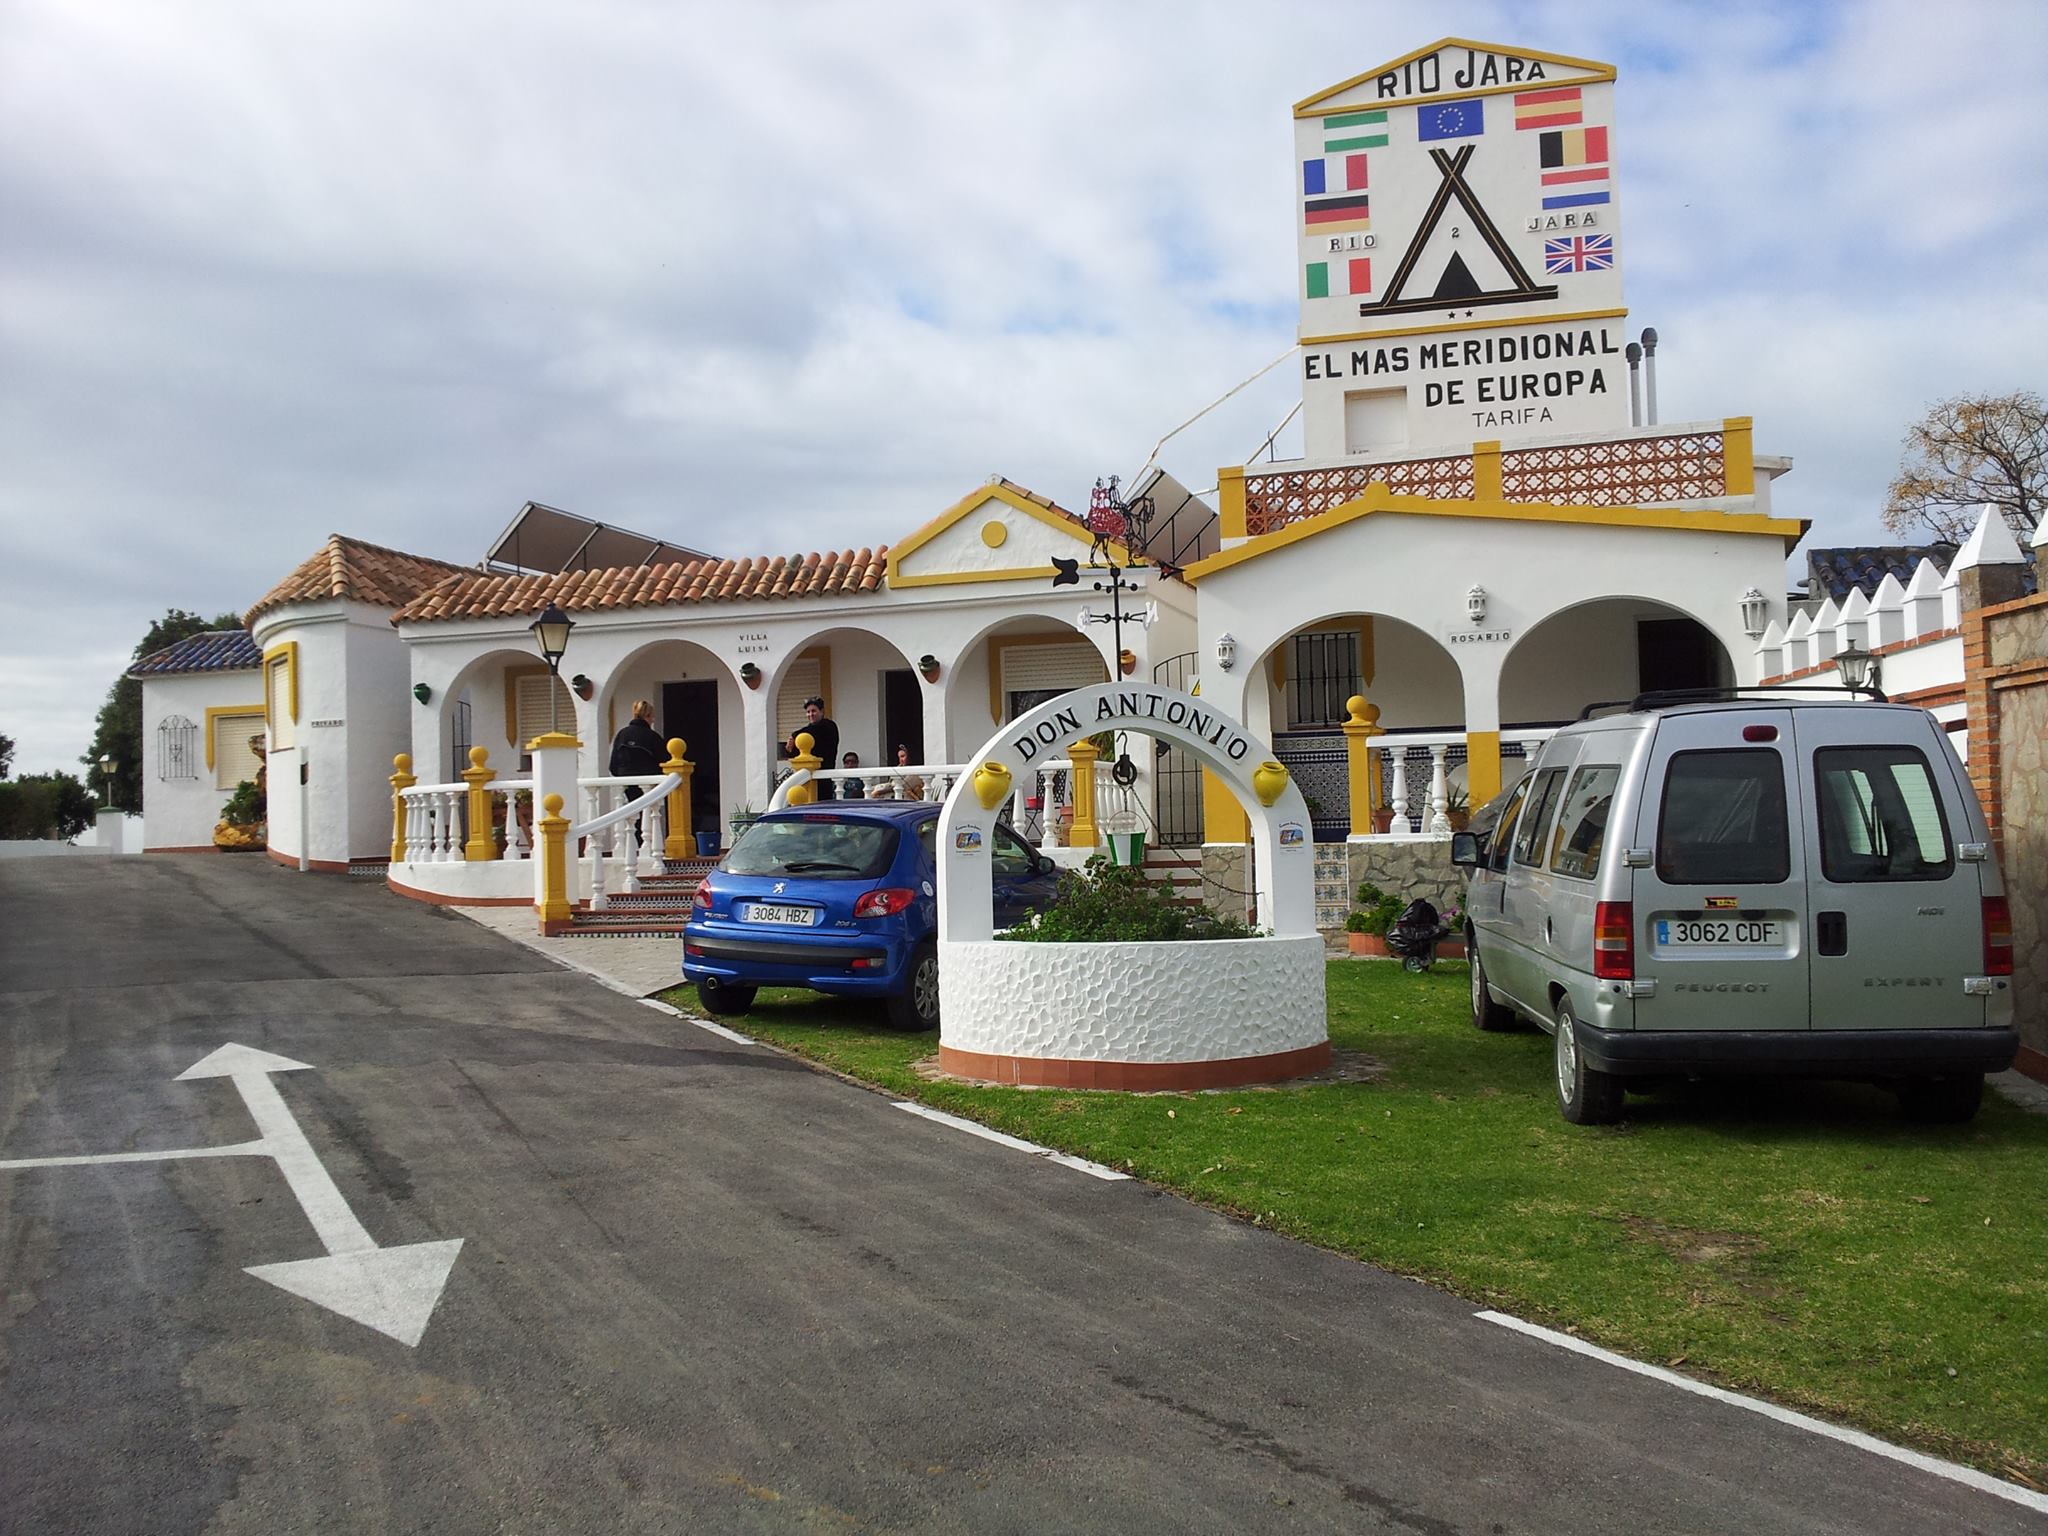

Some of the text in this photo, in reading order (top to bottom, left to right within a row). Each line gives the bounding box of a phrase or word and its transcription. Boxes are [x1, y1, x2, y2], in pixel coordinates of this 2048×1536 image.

[1377, 50, 1546, 98] RIO JARA
[1528, 212, 1596, 230] JARA
[1451, 227, 1460, 239] 2
[1330, 234, 1376, 251] RIO
[1305, 328, 1619, 380] EL MAS MERIDIONAL
[1426, 368, 1607, 407] DE EUROPA
[1472, 407, 1553, 428] TARIFA
[1450, 632, 1510, 643] ROSARIO
[738, 645, 769, 653] LUISA
[1013, 692, 1249, 763] DON ANTONIO
[753, 906, 809, 923] 3084 HBZ
[1676, 923, 1775, 942] 3062 CDF
[1674, 983, 1769, 993] PEUGEOT
[1863, 977, 1945, 987] EXPERT
